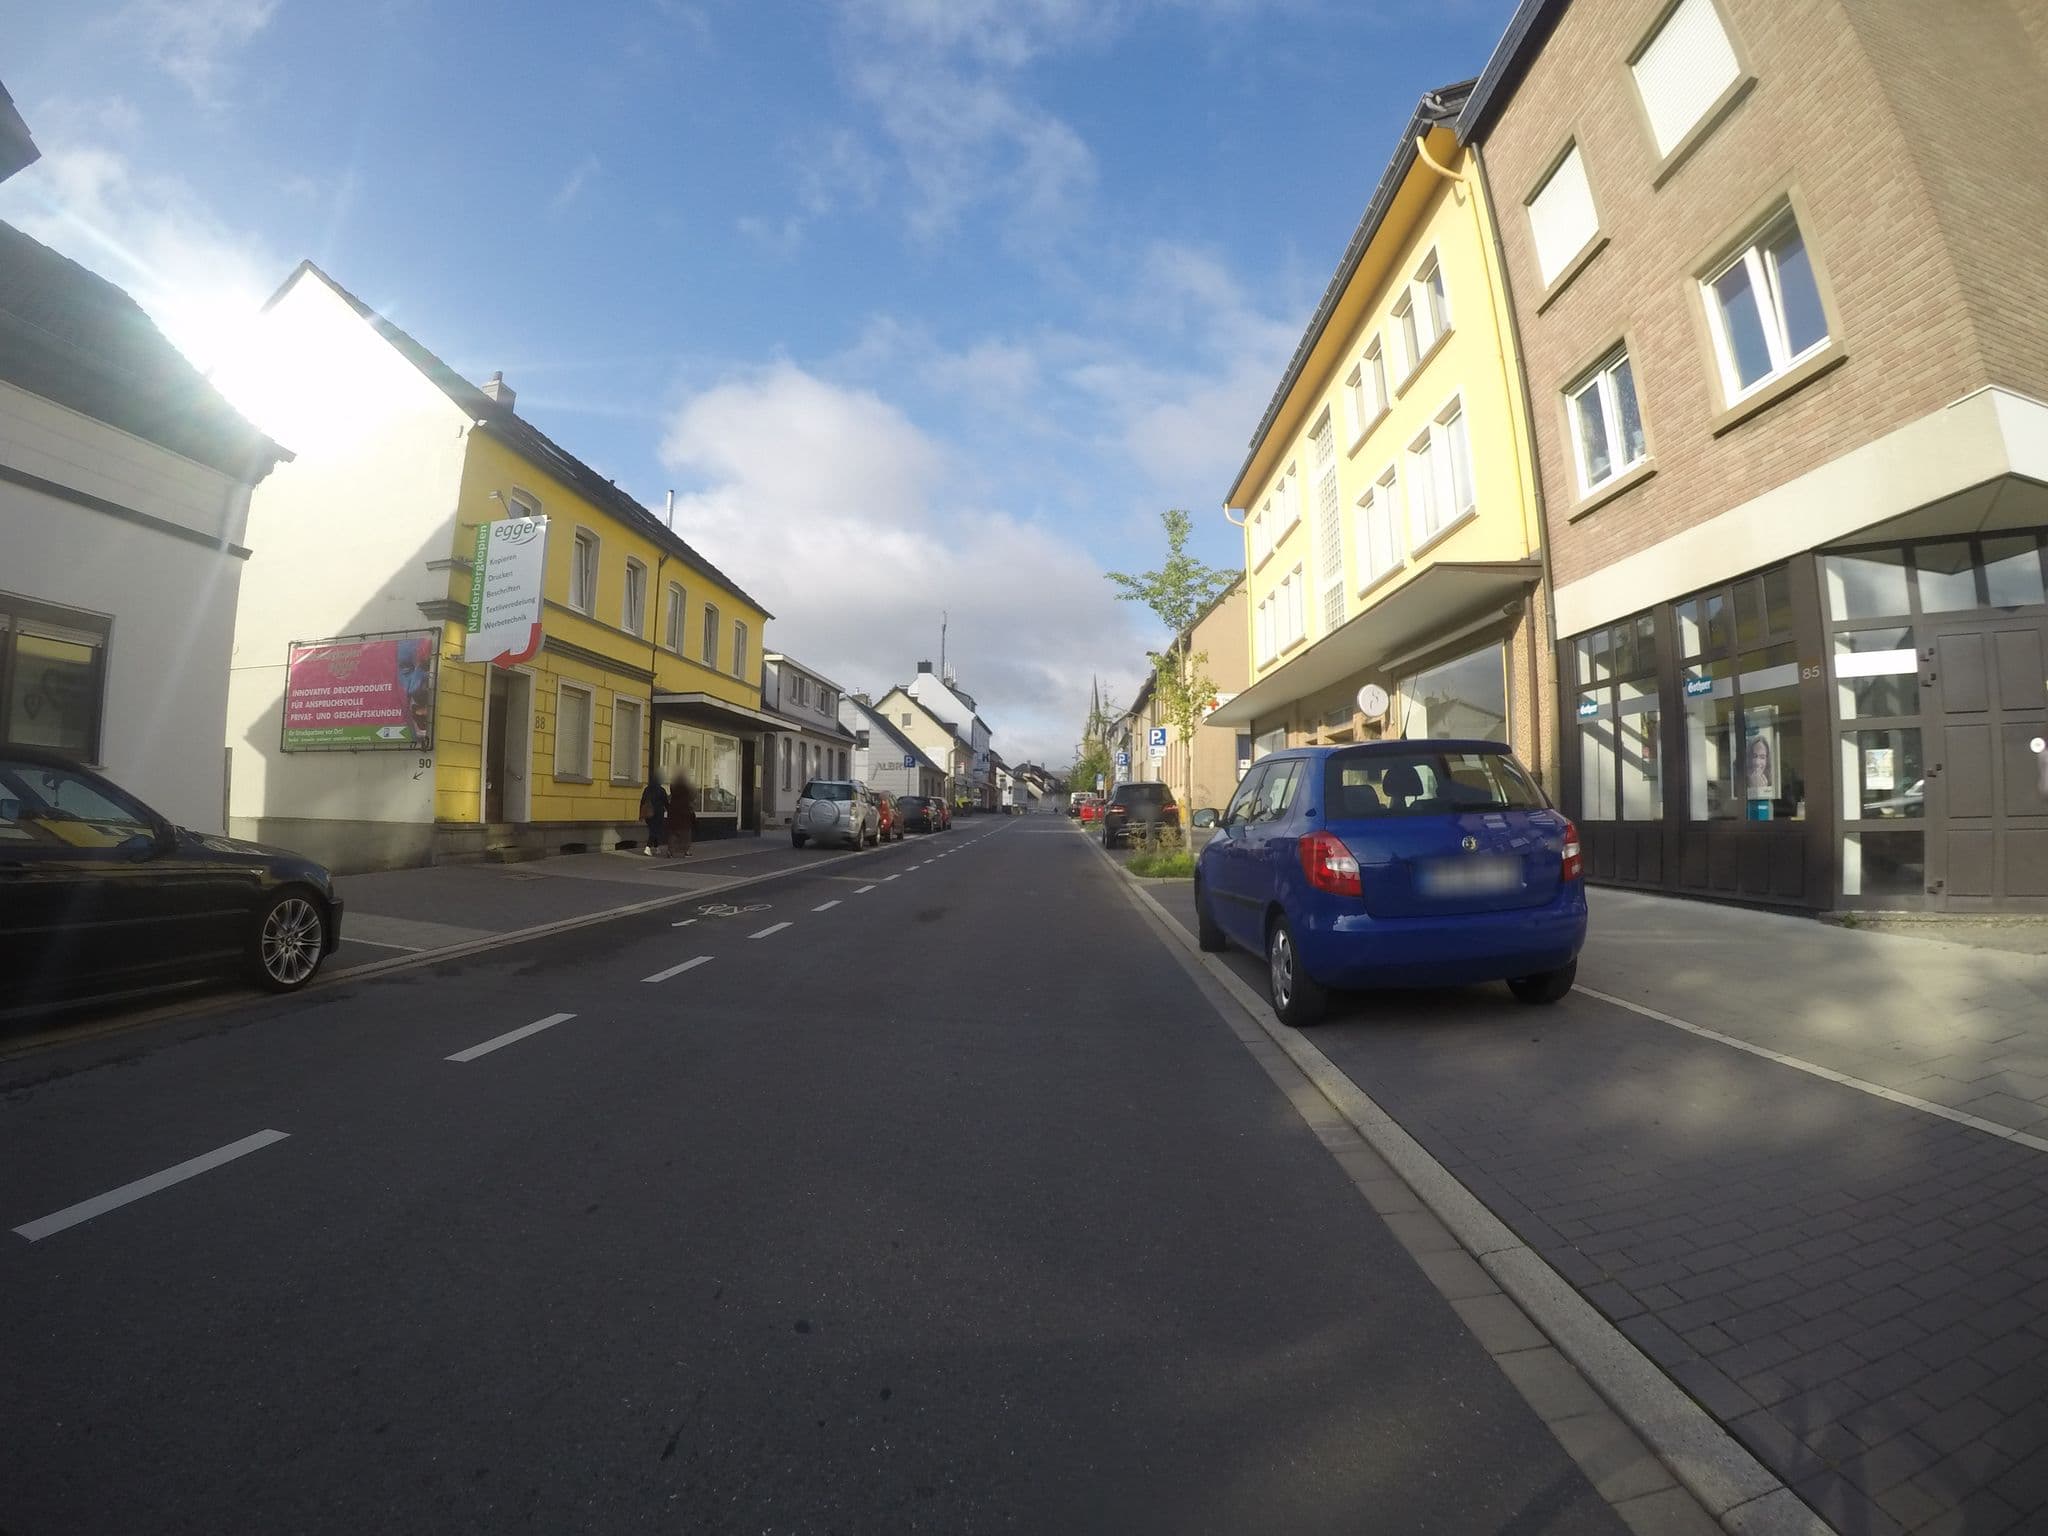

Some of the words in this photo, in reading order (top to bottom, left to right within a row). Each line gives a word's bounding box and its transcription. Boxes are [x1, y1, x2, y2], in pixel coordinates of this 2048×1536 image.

[495, 521, 541, 541] egger
[490, 554, 517, 566] Kopieren
[468, 525, 488, 632] Niederbergkopien
[488, 570, 514, 582] Drucken
[486, 585, 521, 598] Beschriften
[484, 614, 528, 630] Werbetechnik
[1802, 665, 1820, 680] 85
[292, 687, 331, 697] INNOVATIVE
[333, 683, 393, 695] DRUCKPRODUKTE
[291, 699, 304, 709] FÜR
[305, 698, 364, 708] ANSPRUCHSVOLLE
[316, 712, 332, 720] UND
[334, 709, 402, 719] GESCHÄFTSKUNDEN
[535, 715, 546, 730] 88
[419, 758, 432, 769] 90
